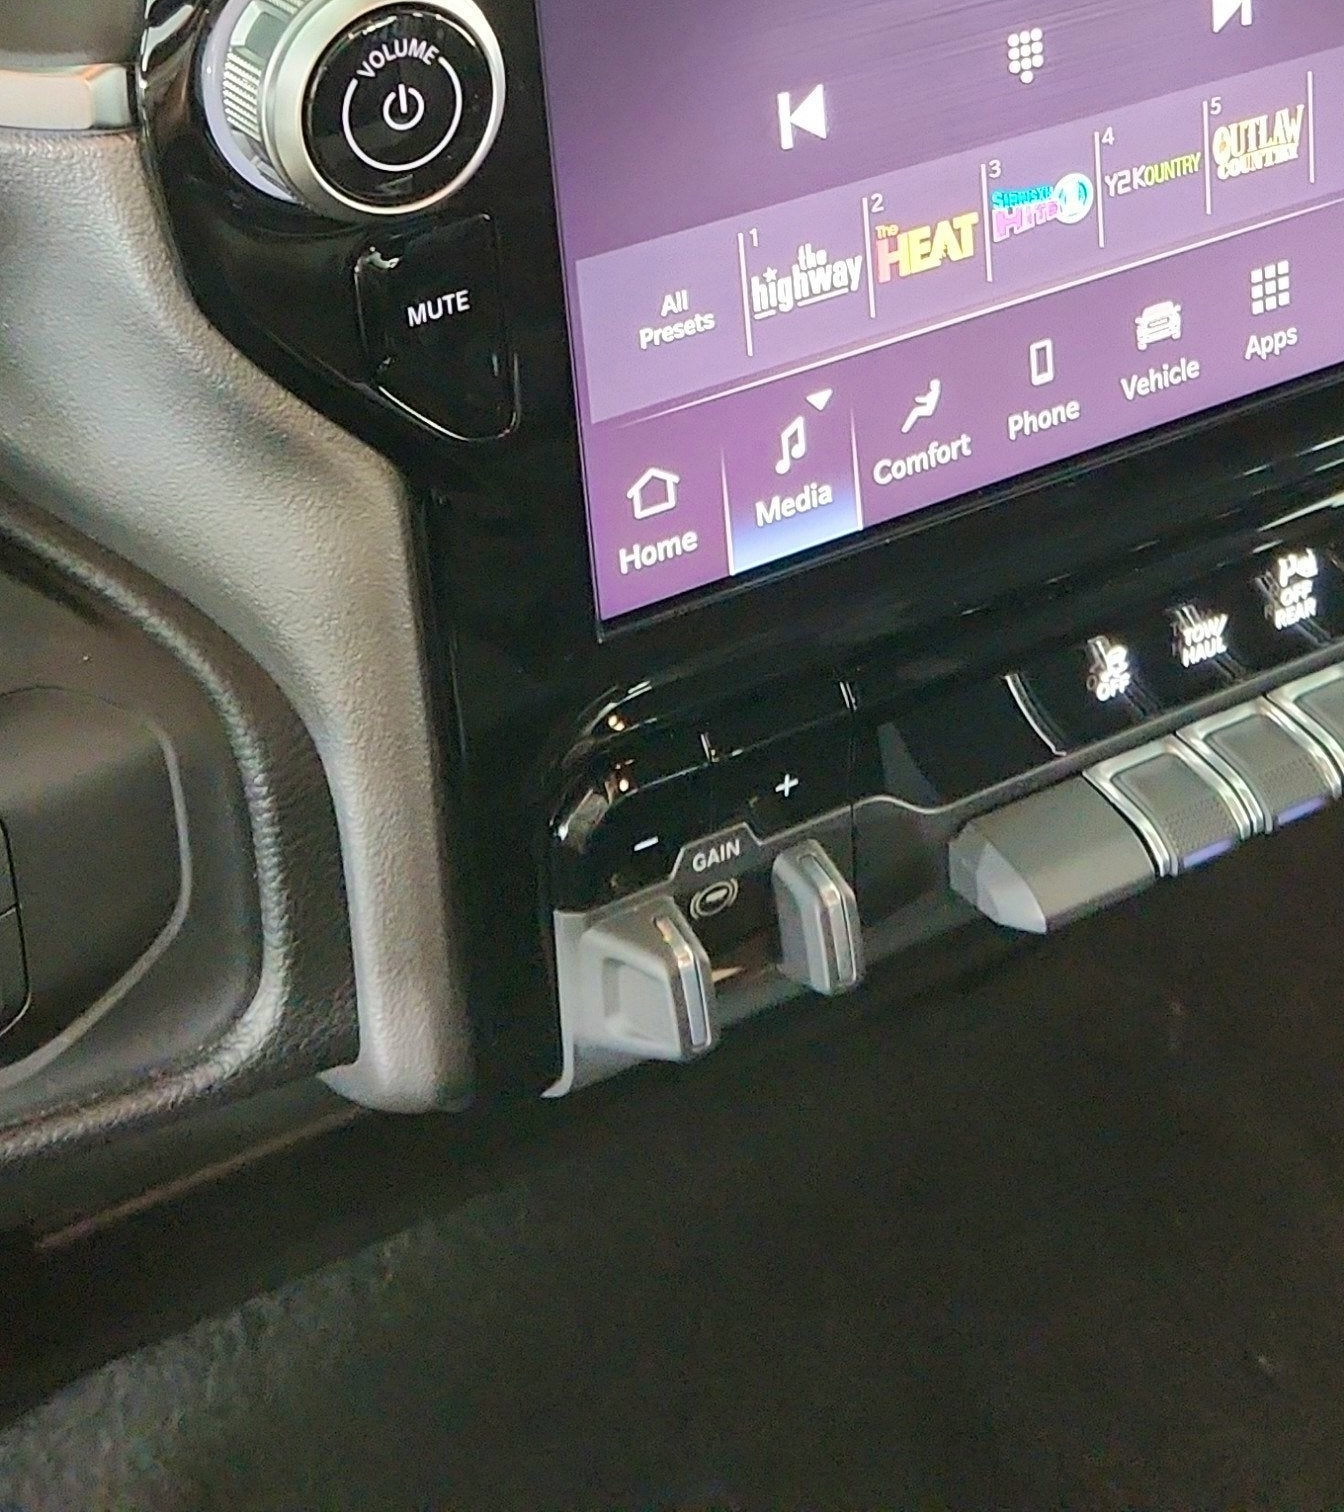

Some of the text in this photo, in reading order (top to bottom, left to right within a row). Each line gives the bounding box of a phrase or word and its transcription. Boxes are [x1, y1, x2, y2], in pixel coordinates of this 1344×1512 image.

[357, 37, 440, 80] VOLUME
[1209, 96, 1223, 116] 5
[1101, 126, 1116, 146] 4
[1212, 103, 1306, 166] OUTLAW
[988, 158, 1002, 179] 3
[870, 192, 885, 213] 2
[748, 227, 759, 248] 1
[875, 211, 979, 284] HEAT
[797, 242, 828, 272] the
[750, 254, 863, 314] highway
[406, 289, 472, 329] MUTE
[660, 289, 690, 319] All
[638, 311, 716, 351] Presets
[1244, 326, 1299, 361] Apps
[1120, 356, 1201, 401] Vehicle
[1007, 399, 1081, 441] Phone
[872, 433, 973, 486] Comfort
[755, 481, 835, 528] Media
[617, 530, 700, 576] Home
[1279, 578, 1314, 607] OFF
[1273, 596, 1317, 631] REAR
[1181, 636, 1229, 668] HAUL
[1096, 677, 1131, 702] OFF
[692, 838, 741, 873] GAIN
